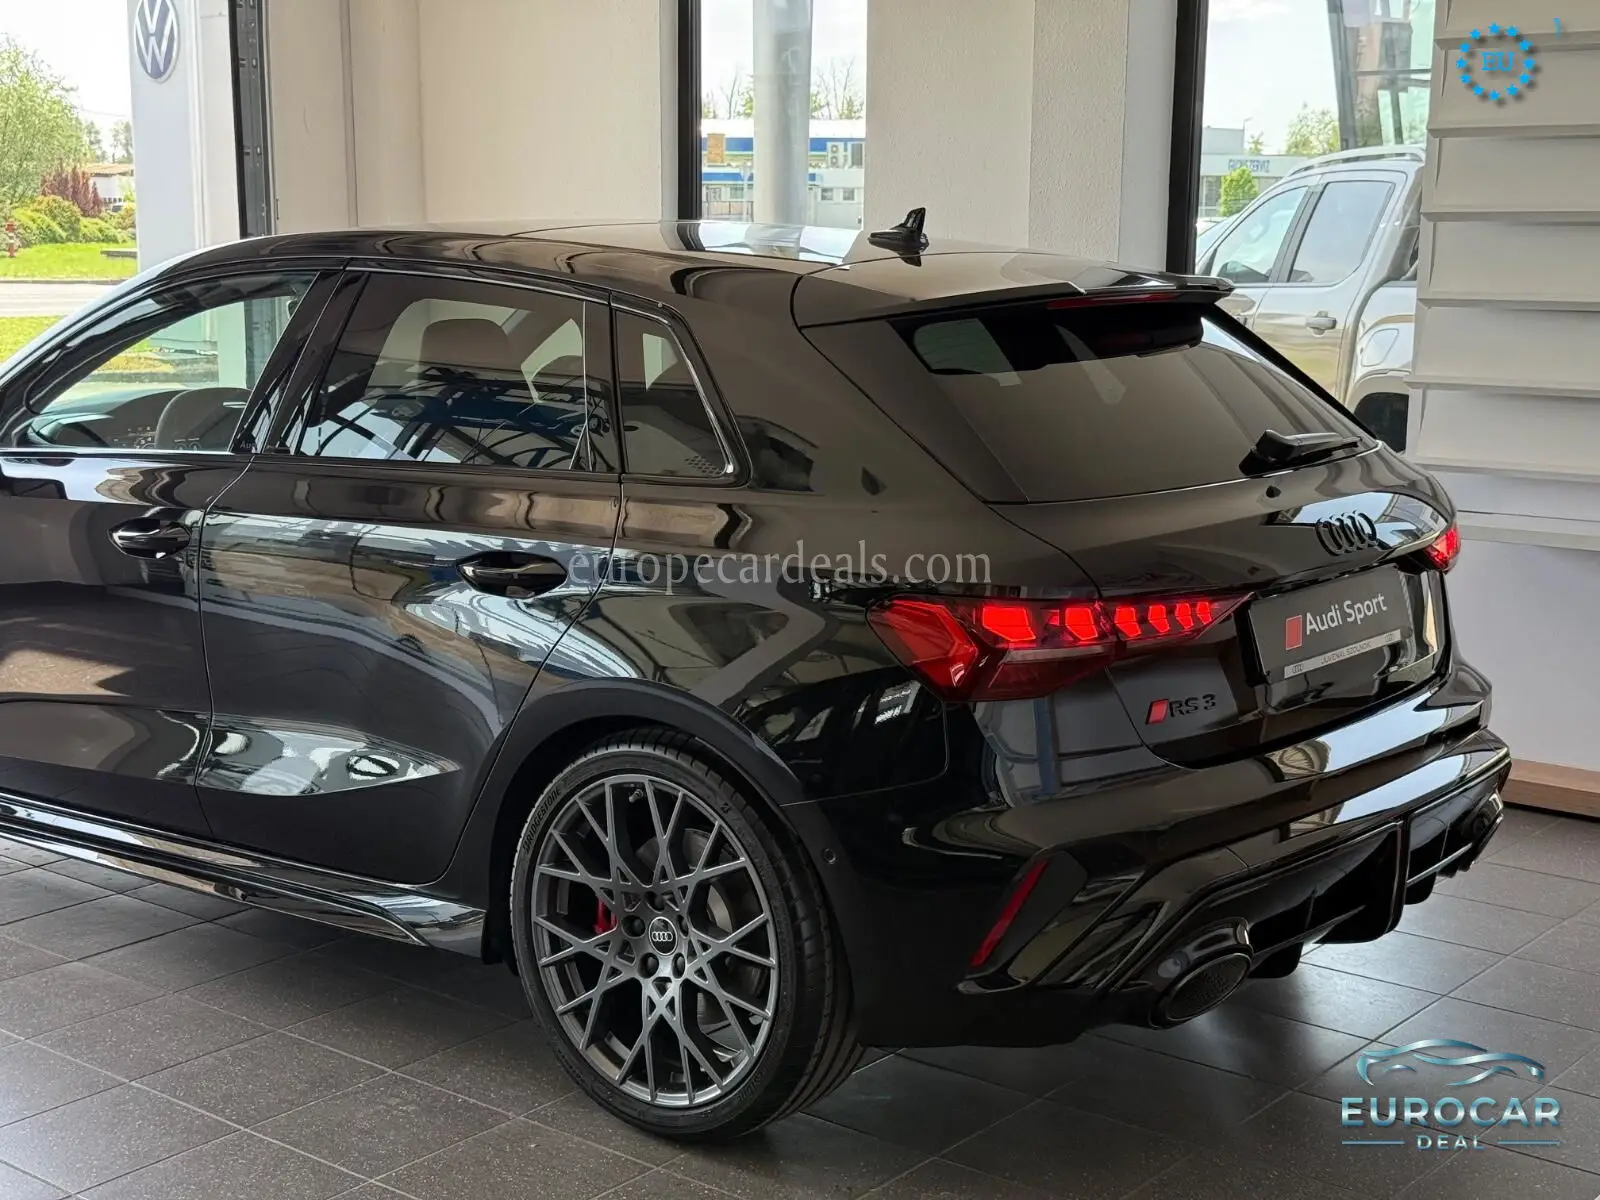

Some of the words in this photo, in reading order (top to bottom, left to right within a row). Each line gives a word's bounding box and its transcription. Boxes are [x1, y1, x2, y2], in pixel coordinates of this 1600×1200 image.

[1306, 604, 1343, 635] Audi
[1343, 593, 1388, 625] Sport
[1169, 697, 1200, 718] RS
[1202, 693, 1216, 711] 3
[522, 786, 562, 855] BRIDGESTONE
